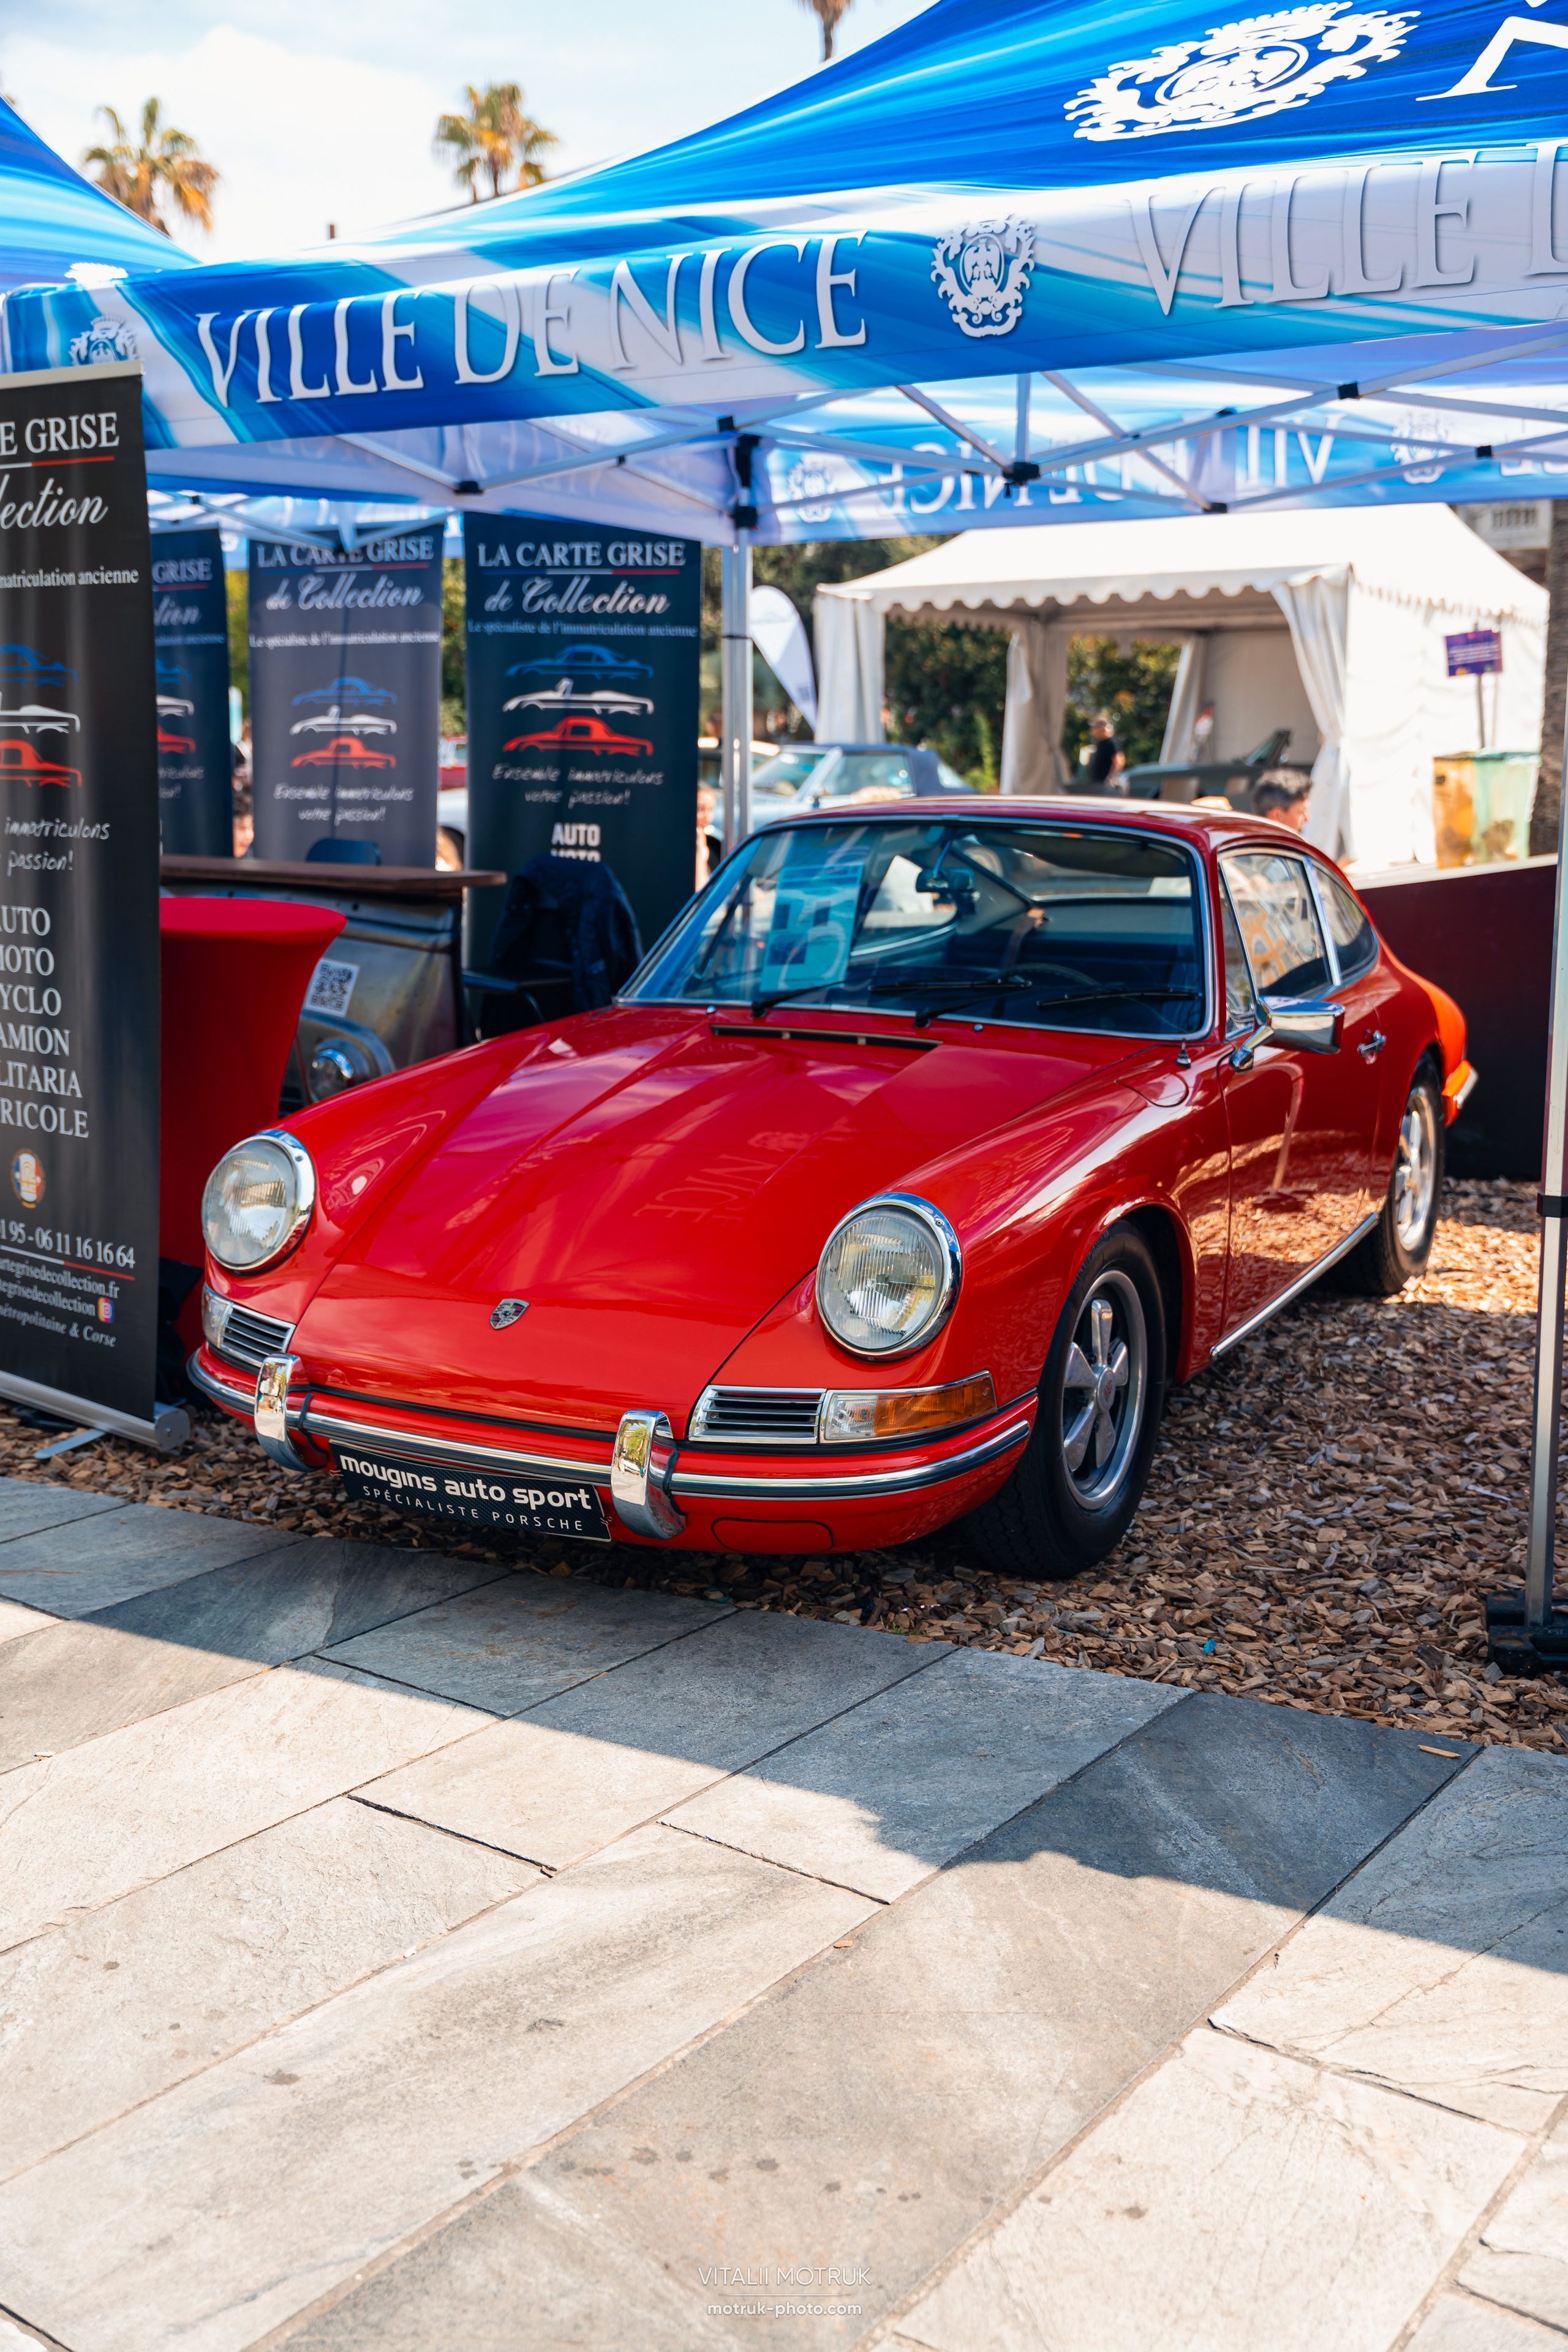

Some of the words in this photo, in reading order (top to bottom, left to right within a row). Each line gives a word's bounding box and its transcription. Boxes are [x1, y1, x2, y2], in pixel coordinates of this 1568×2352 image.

[1122, 151, 1477, 316] VILLE
[195, 288, 424, 407] VILLE
[454, 266, 581, 384] DE
[611, 230, 870, 370] NICE
[25, 412, 119, 454] GRISE
[0, 473, 109, 530] lection
[256, 543, 287, 568] LA
[368, 535, 434, 562] GRISE
[477, 542, 511, 567] LA
[516, 541, 602, 567] CARTE
[607, 541, 687, 567] GRISE
[0, 567, 75, 589] atriculation
[78, 565, 140, 587] ancienne
[152, 557, 213, 584] GRISE
[266, 578, 293, 611] de
[298, 571, 425, 611] Collection
[484, 578, 514, 612] de
[521, 575, 672, 614] Collection
[4, 816, 111, 840] immatriculons
[551, 822, 601, 847] AUTO
[7, 849, 74, 876] passion!
[0, 905, 51, 936] UTO
[0, 944, 55, 976] OTO
[0, 983, 62, 1017] YCLO
[0, 1021, 71, 1057] AMION
[0, 1060, 83, 1098] ITARIA
[0, 1096, 89, 1139] RICOLE
[69, 1322, 80, 1338] &
[83, 1325, 116, 1348] Corse
[339, 1454, 437, 1492] mougins
[445, 1478, 506, 1502] auto
[513, 1488, 592, 1510] sport
[363, 1485, 479, 1519] SPÉCIALISTE
[493, 1511, 583, 1531] PORSCHE
